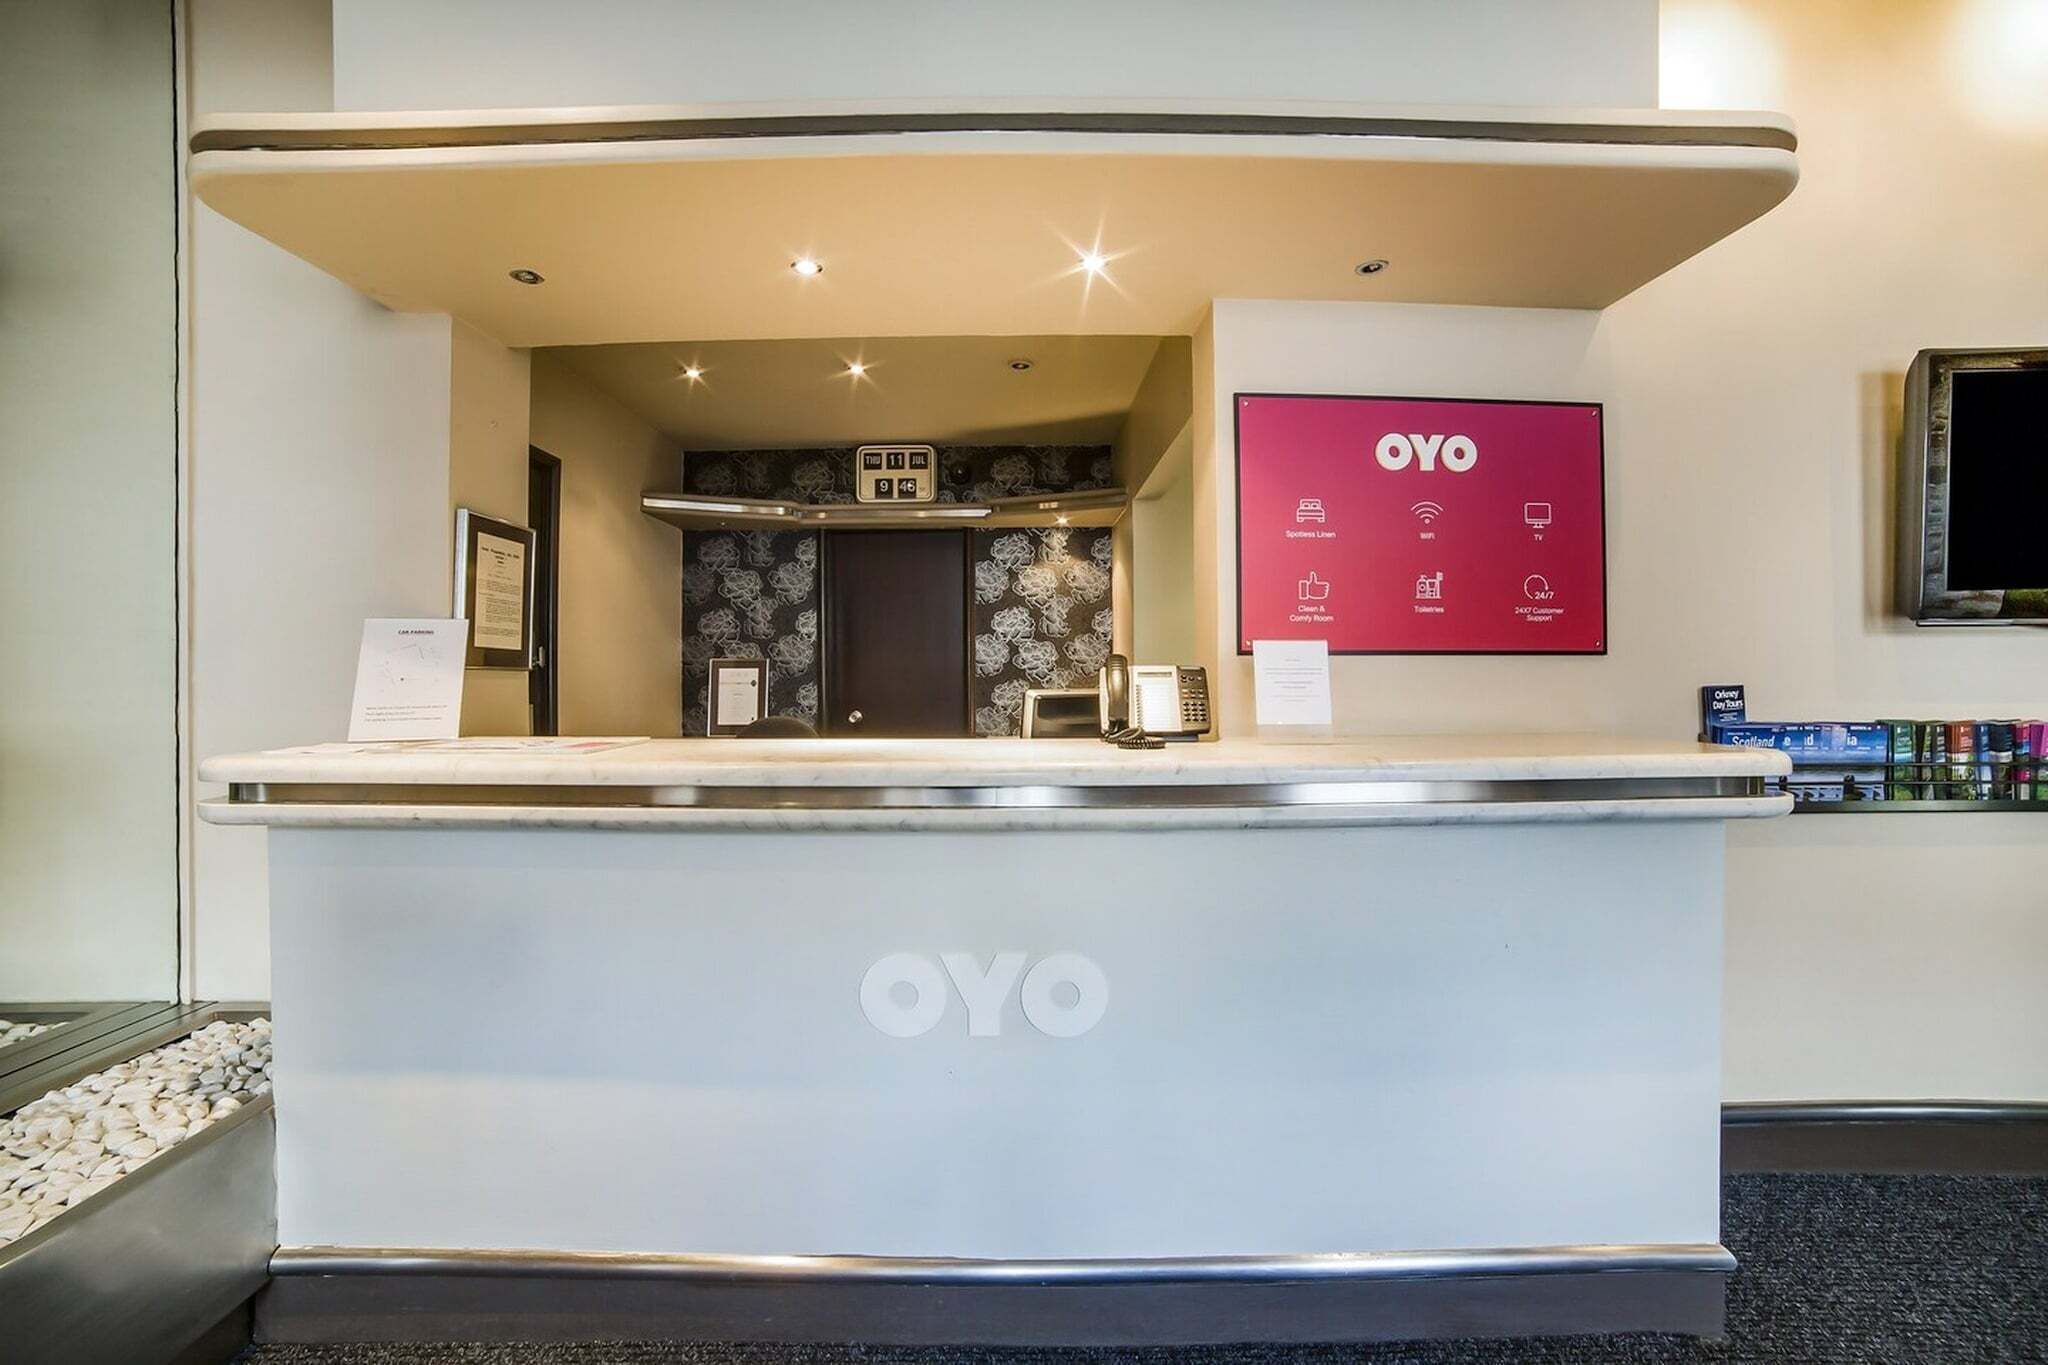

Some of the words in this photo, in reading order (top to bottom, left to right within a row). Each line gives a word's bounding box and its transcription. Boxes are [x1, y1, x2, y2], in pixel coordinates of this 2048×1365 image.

[1375, 432, 1478, 473] OYO
[865, 455, 881, 465] THU
[889, 454, 903, 466] 11
[912, 455, 926, 465] JUL
[879, 480, 889, 493] 9
[899, 480, 916, 493] 46
[1285, 529, 1316, 539] Spotless
[1316, 530, 1337, 539] Linen
[1533, 533, 1544, 541] TV
[1534, 591, 1555, 600] 24/7
[1297, 604, 1319, 613] Clean
[1414, 604, 1445, 614] Toiletries
[1532, 606, 1565, 615] Customer
[1289, 614, 1313, 624] Comfy
[1313, 615, 1335, 623] Room
[1525, 614, 1553, 623] Support
[1714, 690, 1740, 700] Orkney
[1712, 701, 1726, 711] Day
[1731, 735, 1776, 747] Scotland
[858, 952, 1109, 1038] OYO
